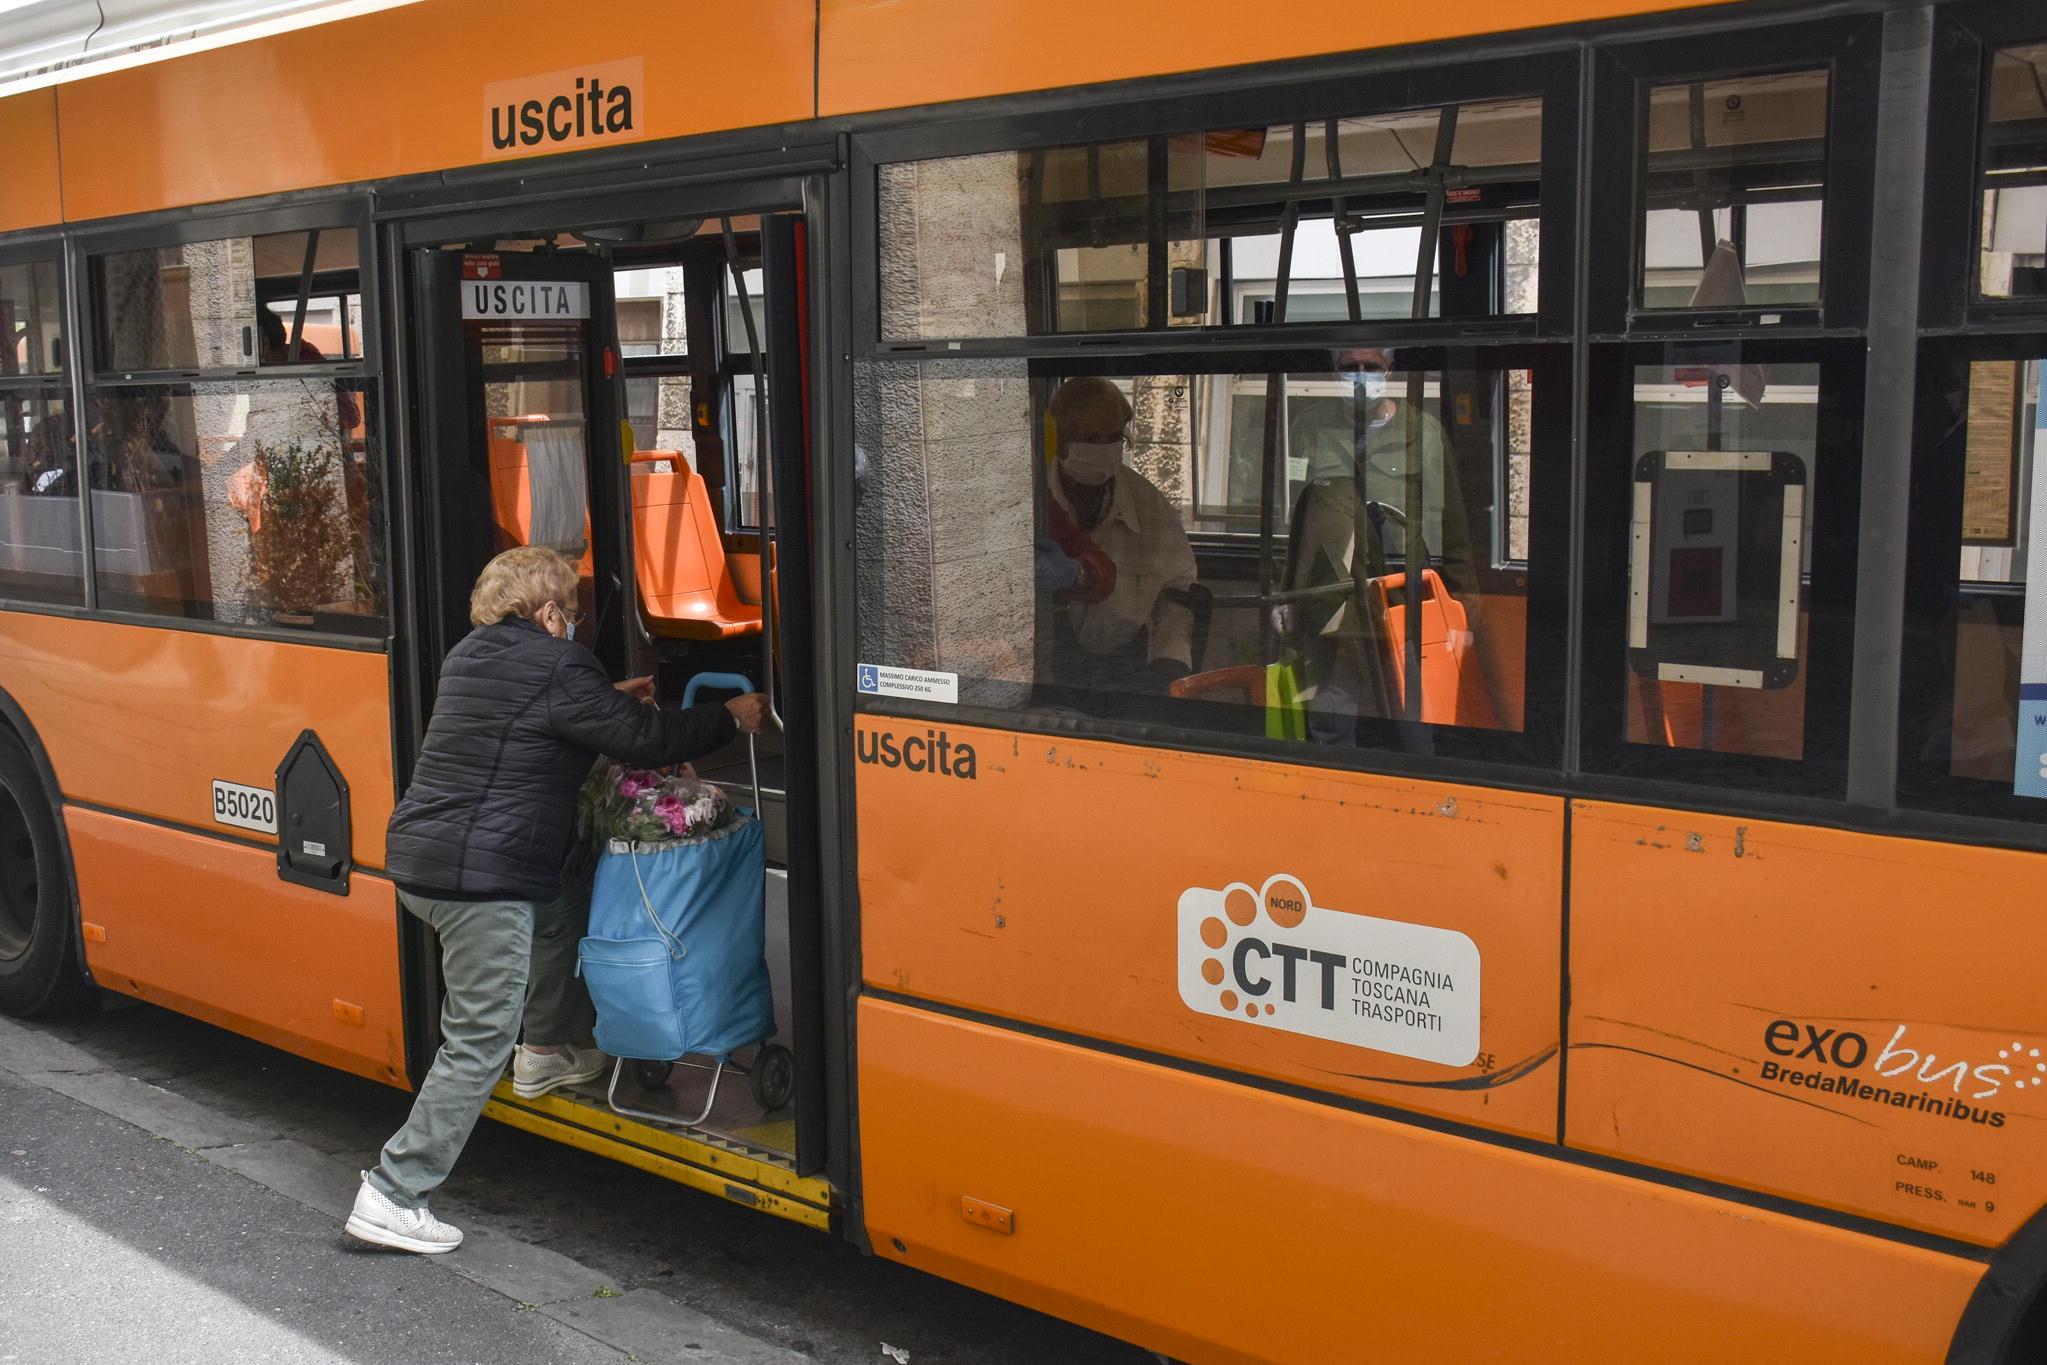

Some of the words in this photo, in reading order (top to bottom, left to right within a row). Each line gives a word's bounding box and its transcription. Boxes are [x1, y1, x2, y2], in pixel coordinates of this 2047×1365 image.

[492, 77, 634, 150] uscita
[475, 285, 570, 314] USCITA
[880, 672, 904, 680] MASSIMO
[904, 674, 923, 683] CARICO
[924, 676, 950, 685] AMMESSO
[880, 681, 913, 691] COMPLESSIVO
[857, 729, 977, 780] uscita
[214, 787, 274, 824] B5020
[1270, 897, 1302, 912] NORD
[1232, 937, 1347, 1011] CTT
[1352, 957, 1454, 992] COMPAGNIA
[1352, 978, 1431, 1009] TOSCANA
[1352, 999, 1442, 1032] TRASPORTI
[1472, 1052, 1495, 1070] SE
[1764, 1019, 1868, 1069] exo
[1874, 1024, 2011, 1099] bus
[1760, 1060, 2007, 1128] BredaMenarinibus
[1896, 1154, 1941, 1173] CAMP.
[1970, 1169, 1996, 1185] 148
[1895, 1181, 1947, 1202] PRESS.
[1958, 1199, 1976, 1208] BAR
[1985, 1201, 1995, 1213] 9
